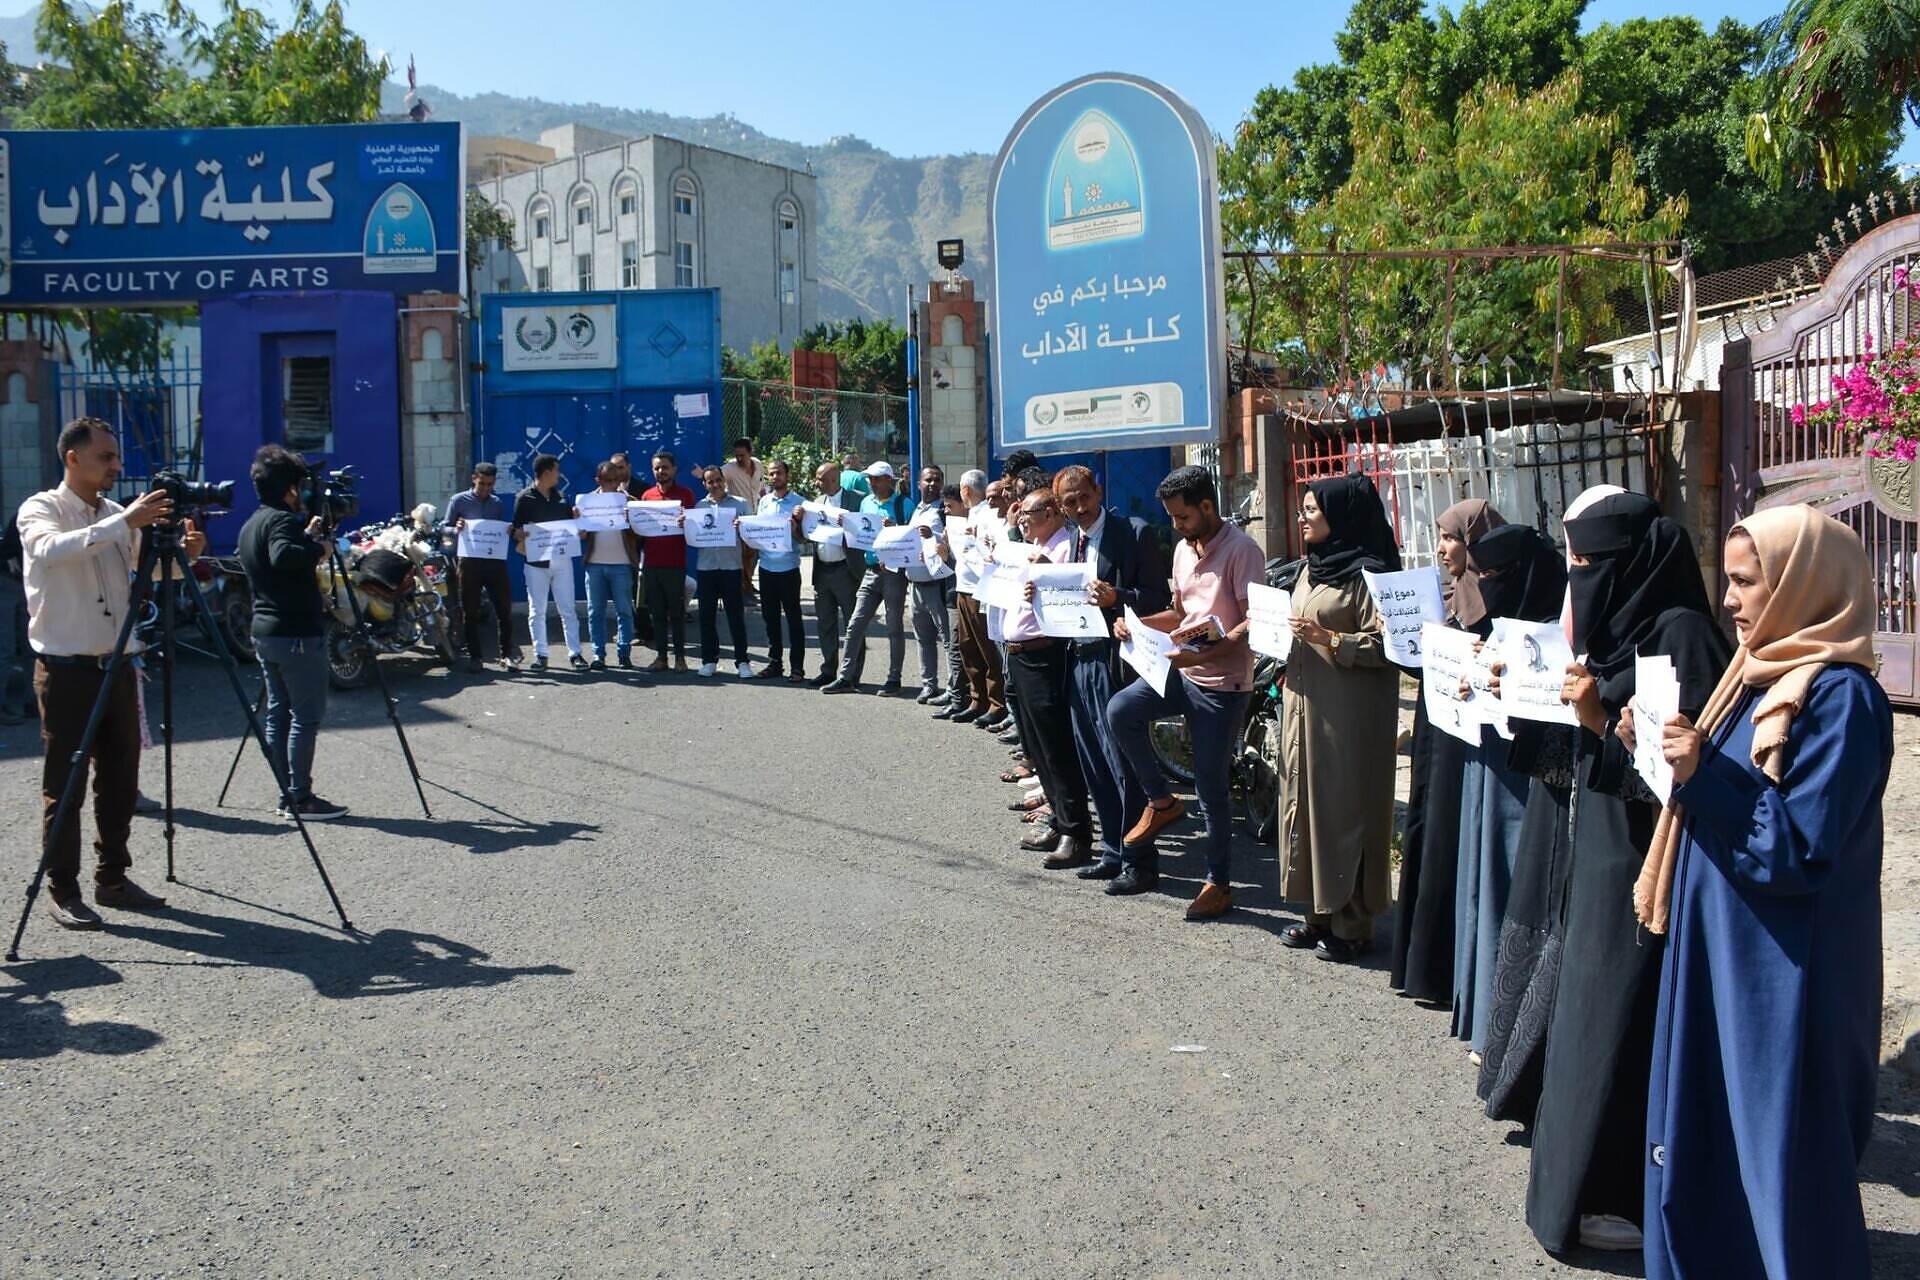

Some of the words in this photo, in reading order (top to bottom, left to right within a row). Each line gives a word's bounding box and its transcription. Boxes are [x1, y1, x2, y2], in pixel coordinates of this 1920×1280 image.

[397, 165, 426, 175] جامعة
[44, 271, 181, 293] FACULTY
[196, 269, 235, 290] OF
[249, 267, 329, 288] ARTS
[1071, 276, 1108, 307] بكم
[1113, 273, 1167, 299] مرحبا
[1033, 283, 1064, 316] في
[1022, 322, 1088, 365] الآداب
[1097, 313, 1182, 353] كلية
[1395, 589, 1416, 601] دموع
